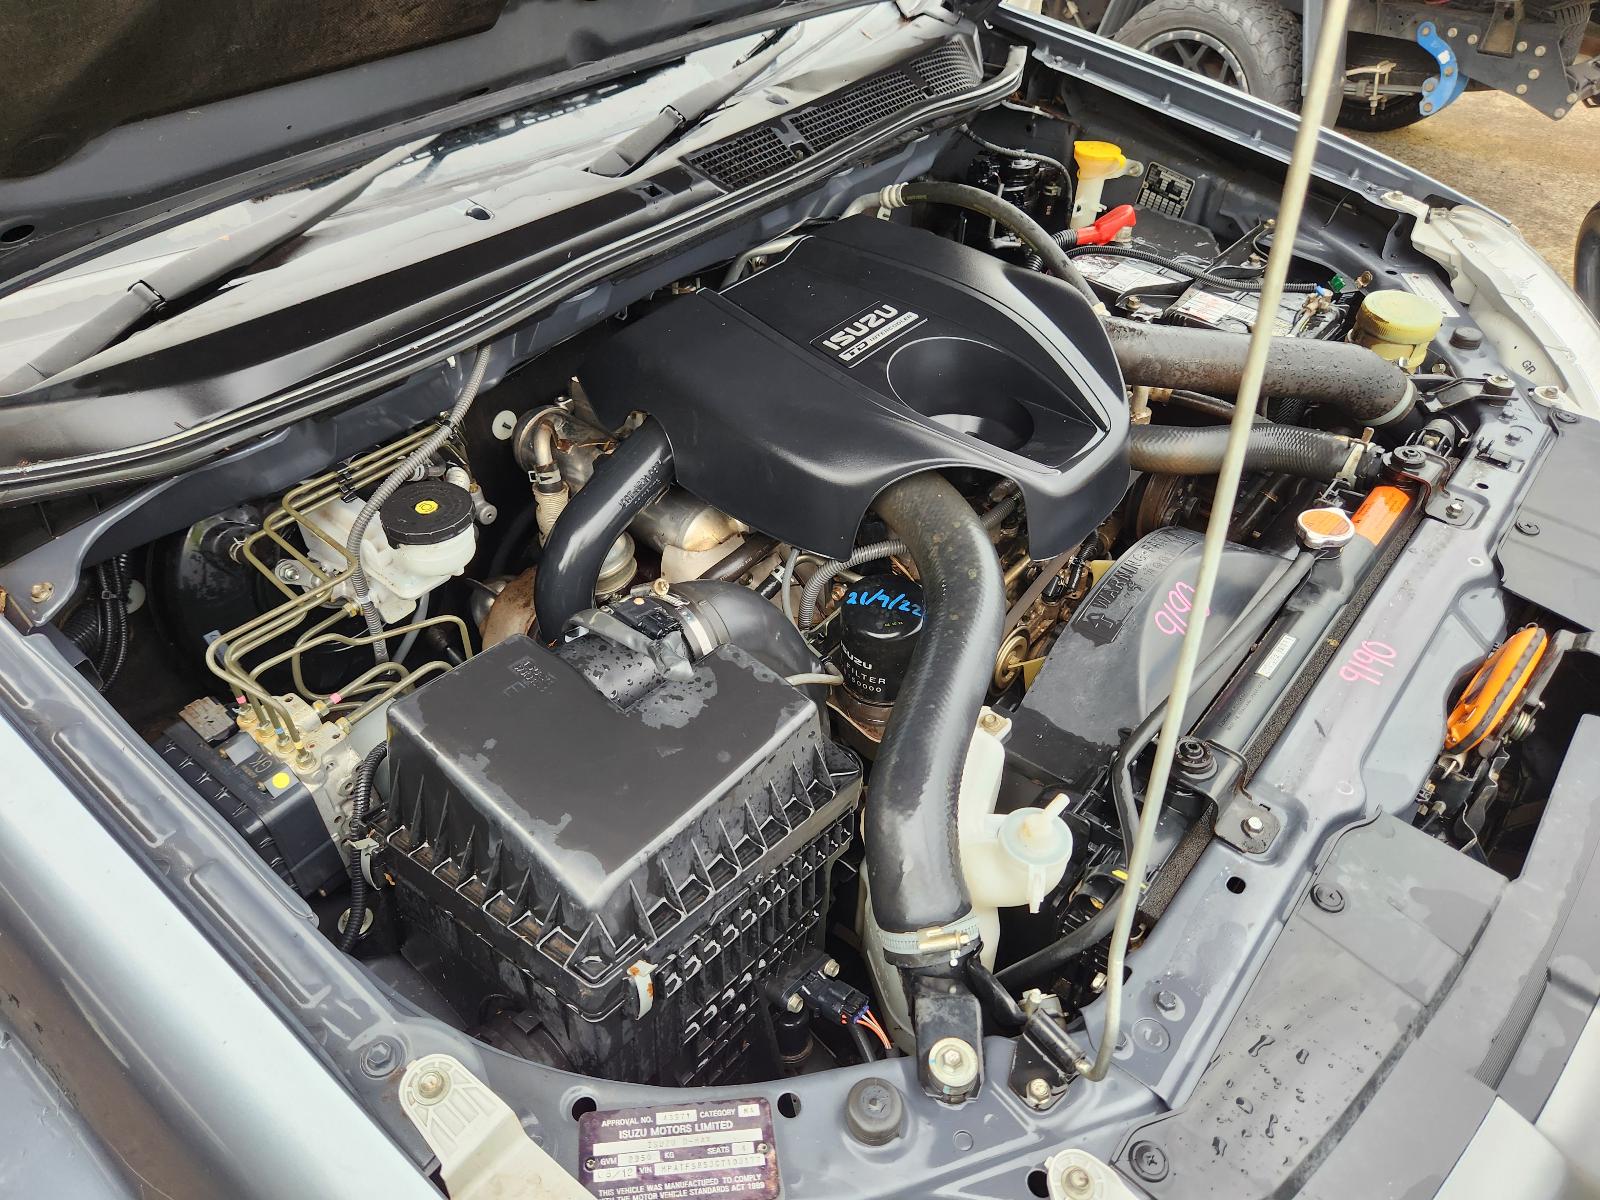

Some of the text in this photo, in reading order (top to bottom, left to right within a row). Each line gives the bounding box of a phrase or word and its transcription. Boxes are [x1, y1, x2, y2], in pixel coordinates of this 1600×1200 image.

[822, 304, 898, 351] ISUZU
[1521, 359, 1537, 376] GR
[1339, 640, 1397, 685] 9190
[601, 1117, 639, 1128] APPROVAL
[640, 1116, 653, 1124] NO.
[700, 1109, 736, 1118] CATEGORY
[618, 1120, 734, 1140] ISUZU MOTORS LIMITED
[600, 1157, 617, 1166] GVM
[664, 1151, 675, 1159] KG
[707, 1146, 730, 1155] SEATS
[639, 1166, 653, 1174] VIN
[598, 1173, 762, 1197] THIS VEHICLE WAS MANUFACTURED TO COMPLY
[659, 1189, 688, 1199] VEHICLE
[689, 1185, 730, 1196] STANDARDS
[731, 1184, 746, 1192] ACT
